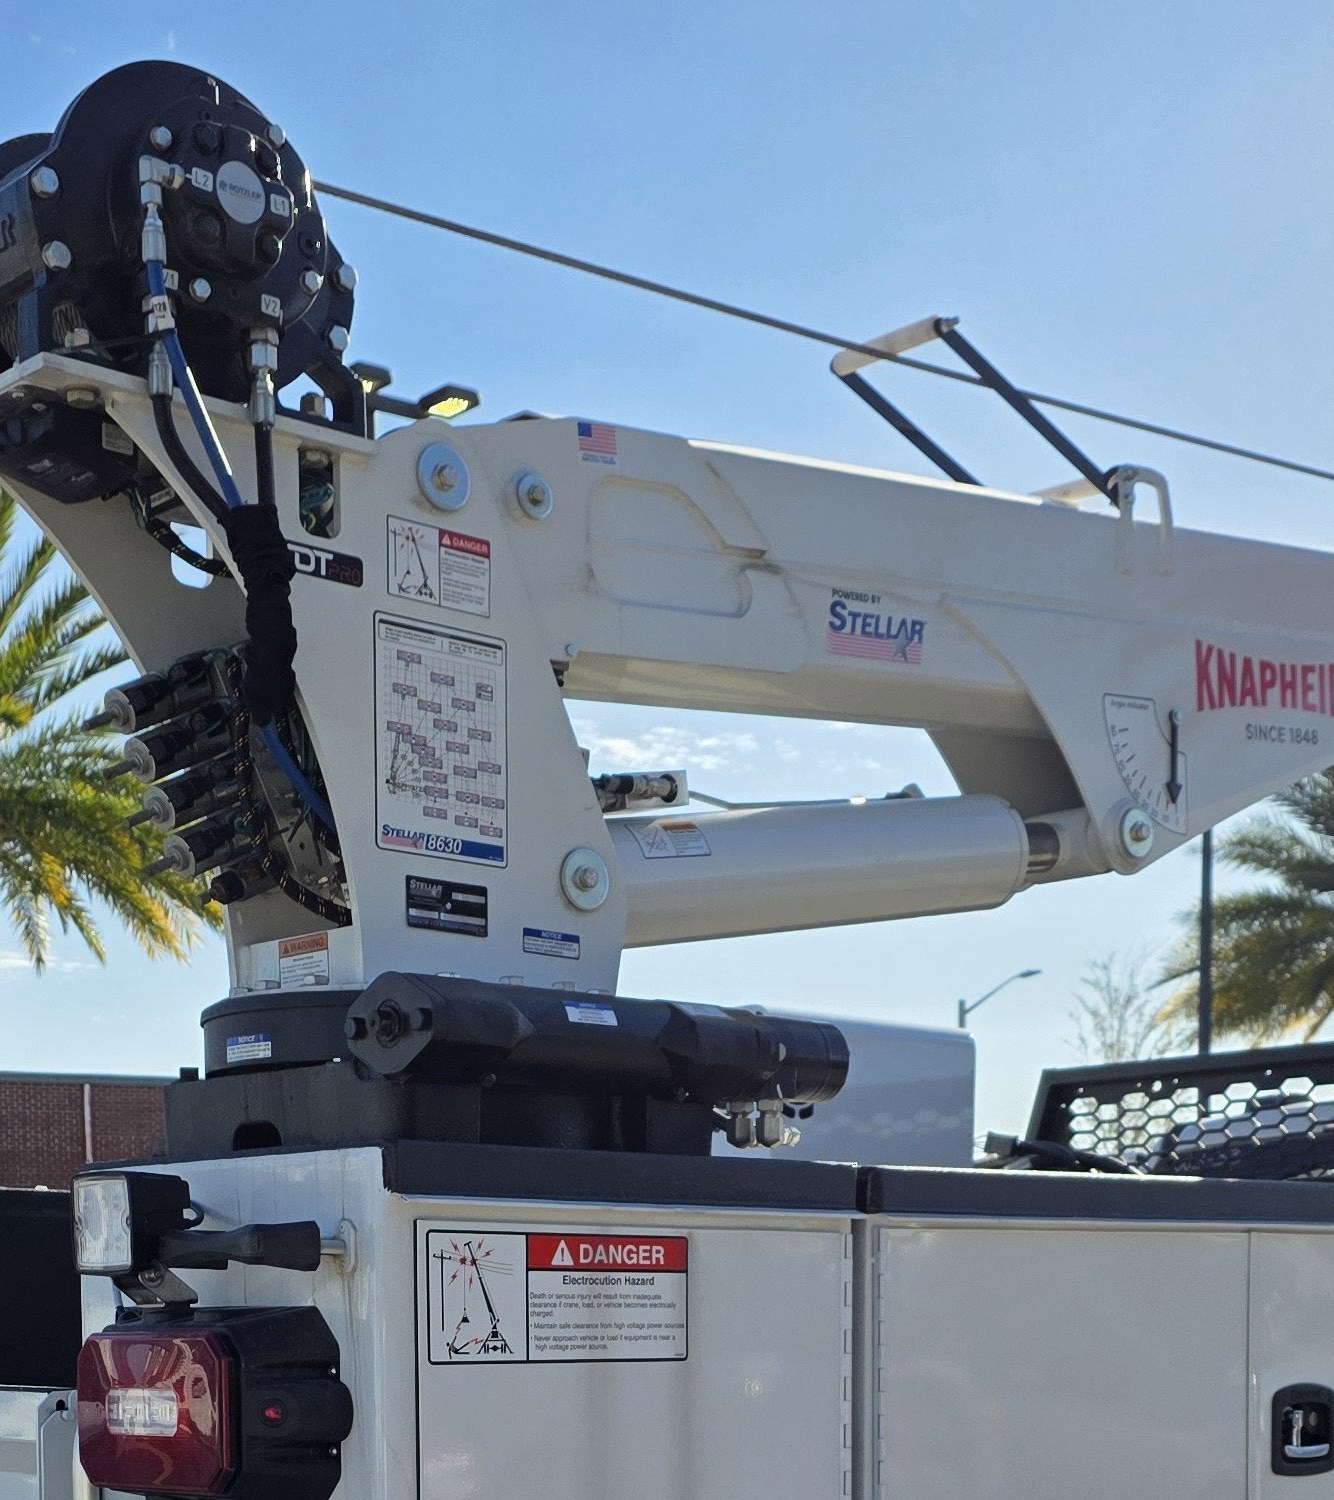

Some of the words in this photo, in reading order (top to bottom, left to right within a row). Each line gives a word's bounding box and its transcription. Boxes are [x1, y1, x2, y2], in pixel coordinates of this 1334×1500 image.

[195, 172, 210, 187] L2
[275, 198, 286, 212] L1
[264, 298, 277, 314] V2
[452, 536, 488, 553] DANGER
[832, 589, 869, 602] POWERED
[871, 594, 881, 604] BY
[829, 600, 925, 643] STELLAR
[1246, 723, 1286, 743] SINCE
[382, 824, 425, 841] STELLAR
[428, 834, 462, 853] 8630
[410, 879, 442, 892] STELLAR
[290, 936, 324, 952] WARNING
[579, 1244, 664, 1264] DANGER
[562, 1275, 621, 1285] Electrocution
[624, 1276, 654, 1286] Hazard
